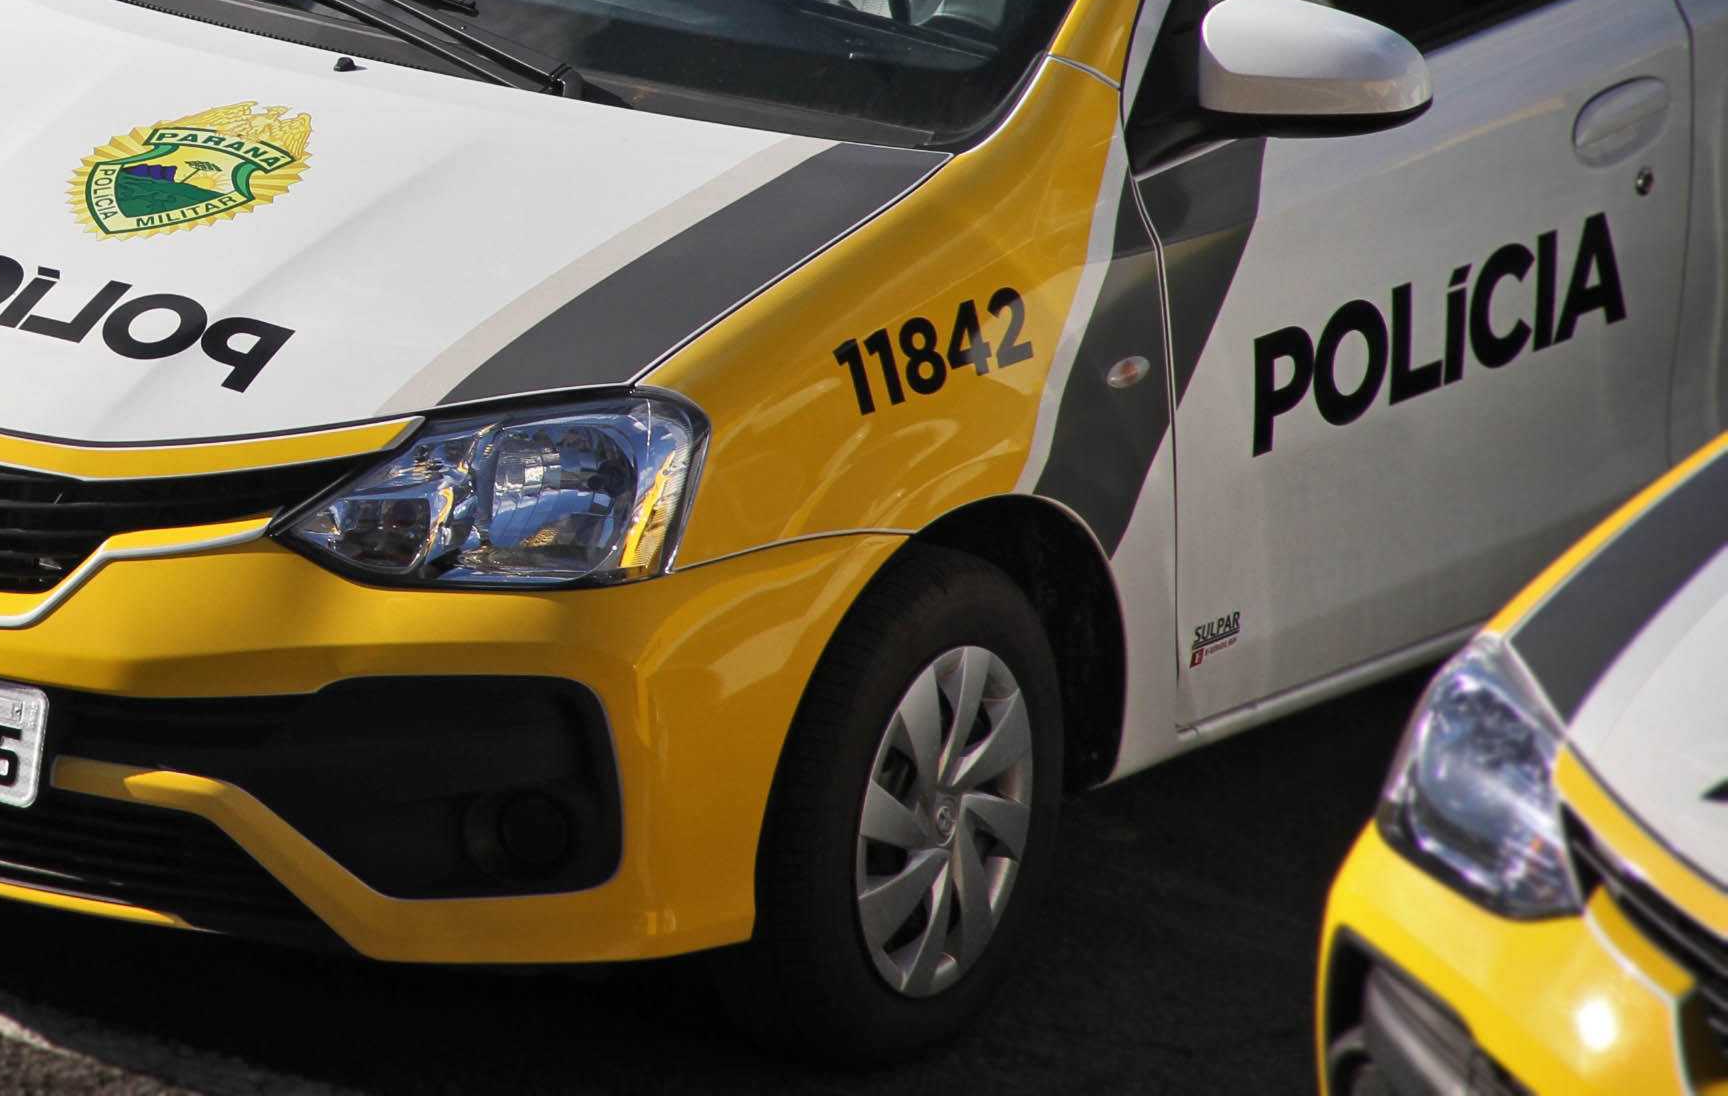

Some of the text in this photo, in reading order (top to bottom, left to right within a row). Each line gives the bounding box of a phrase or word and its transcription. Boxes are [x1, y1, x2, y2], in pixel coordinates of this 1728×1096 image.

[156, 132, 286, 170] PARANÁ
[136, 195, 238, 228] MILITAR
[833, 286, 1035, 416] 11842
[1194, 611, 1241, 641] SULPAR
